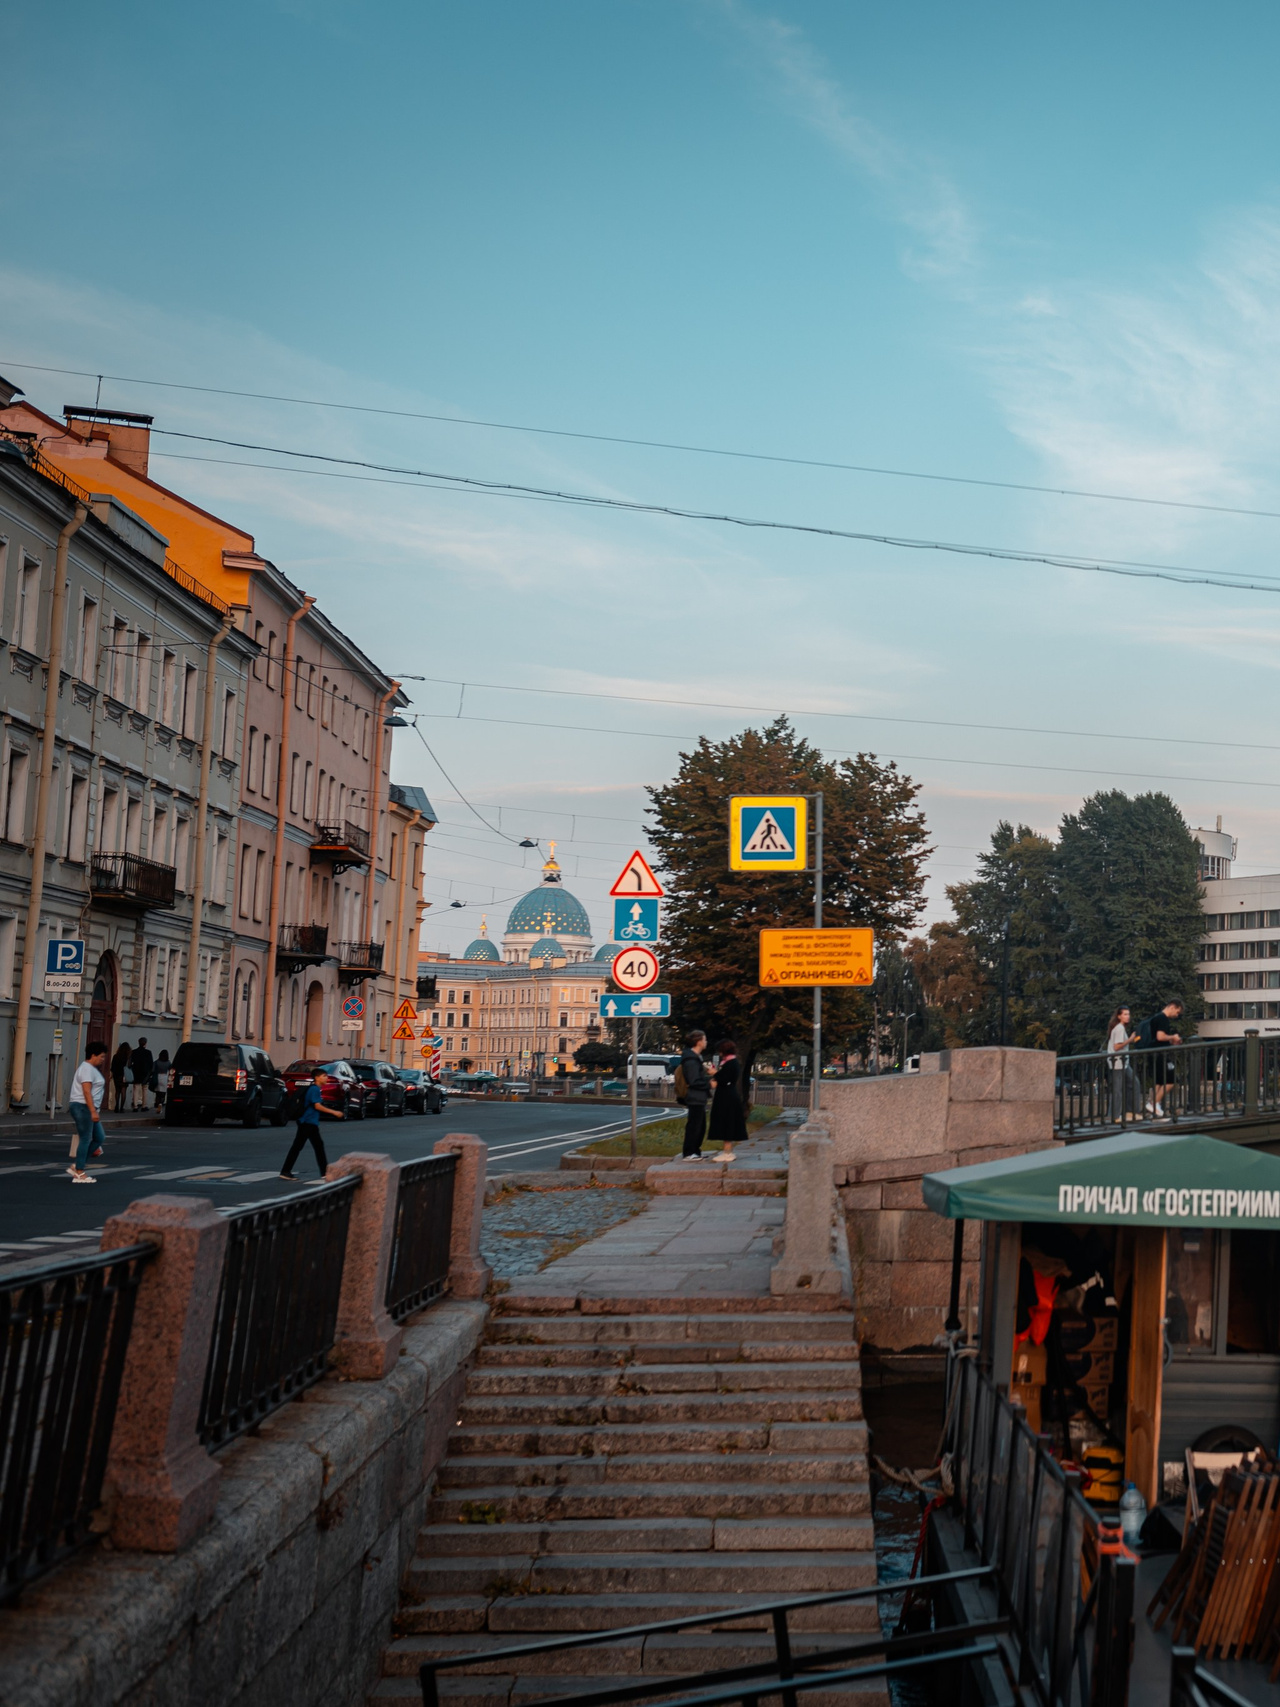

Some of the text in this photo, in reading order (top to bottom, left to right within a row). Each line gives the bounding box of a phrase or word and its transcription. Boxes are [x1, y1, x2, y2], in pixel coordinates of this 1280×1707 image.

[56, 943, 77, 969] P
[622, 961, 649, 978] 40
[780, 970, 854, 980] ОГРАНИЧЕНО
[46, 980, 80, 988] 8.00-20.00
[1058, 1184, 1139, 1215] ПРИЧАЛ
